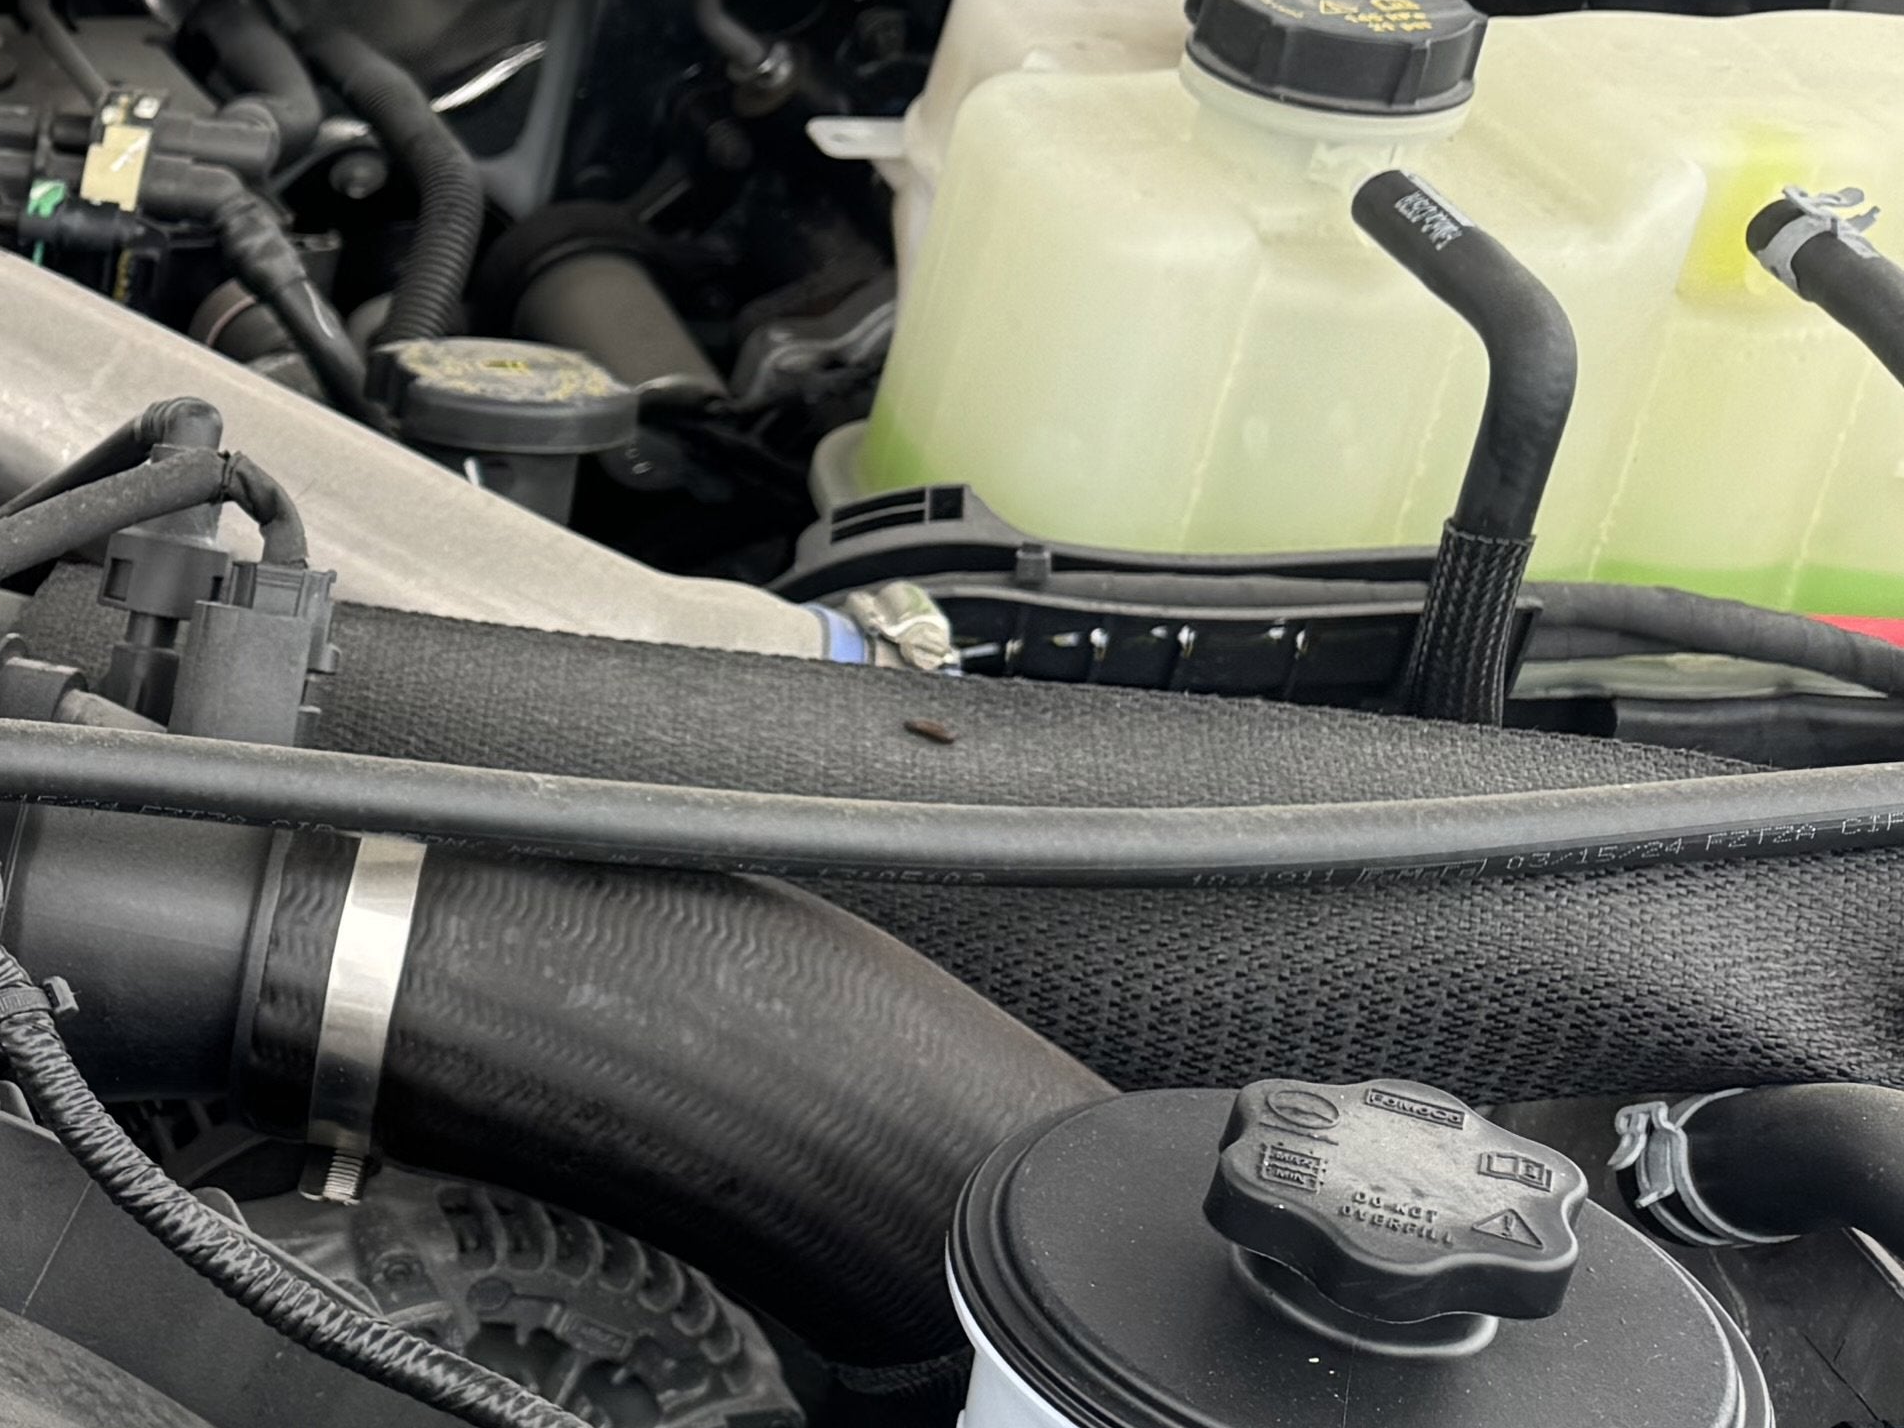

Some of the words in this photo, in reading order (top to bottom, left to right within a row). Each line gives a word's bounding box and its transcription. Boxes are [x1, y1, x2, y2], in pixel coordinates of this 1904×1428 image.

[1352, 1190, 1383, 1207] DO
[1392, 1202, 1439, 1223] NOT
[1338, 1205, 1454, 1248] OVERFILL
